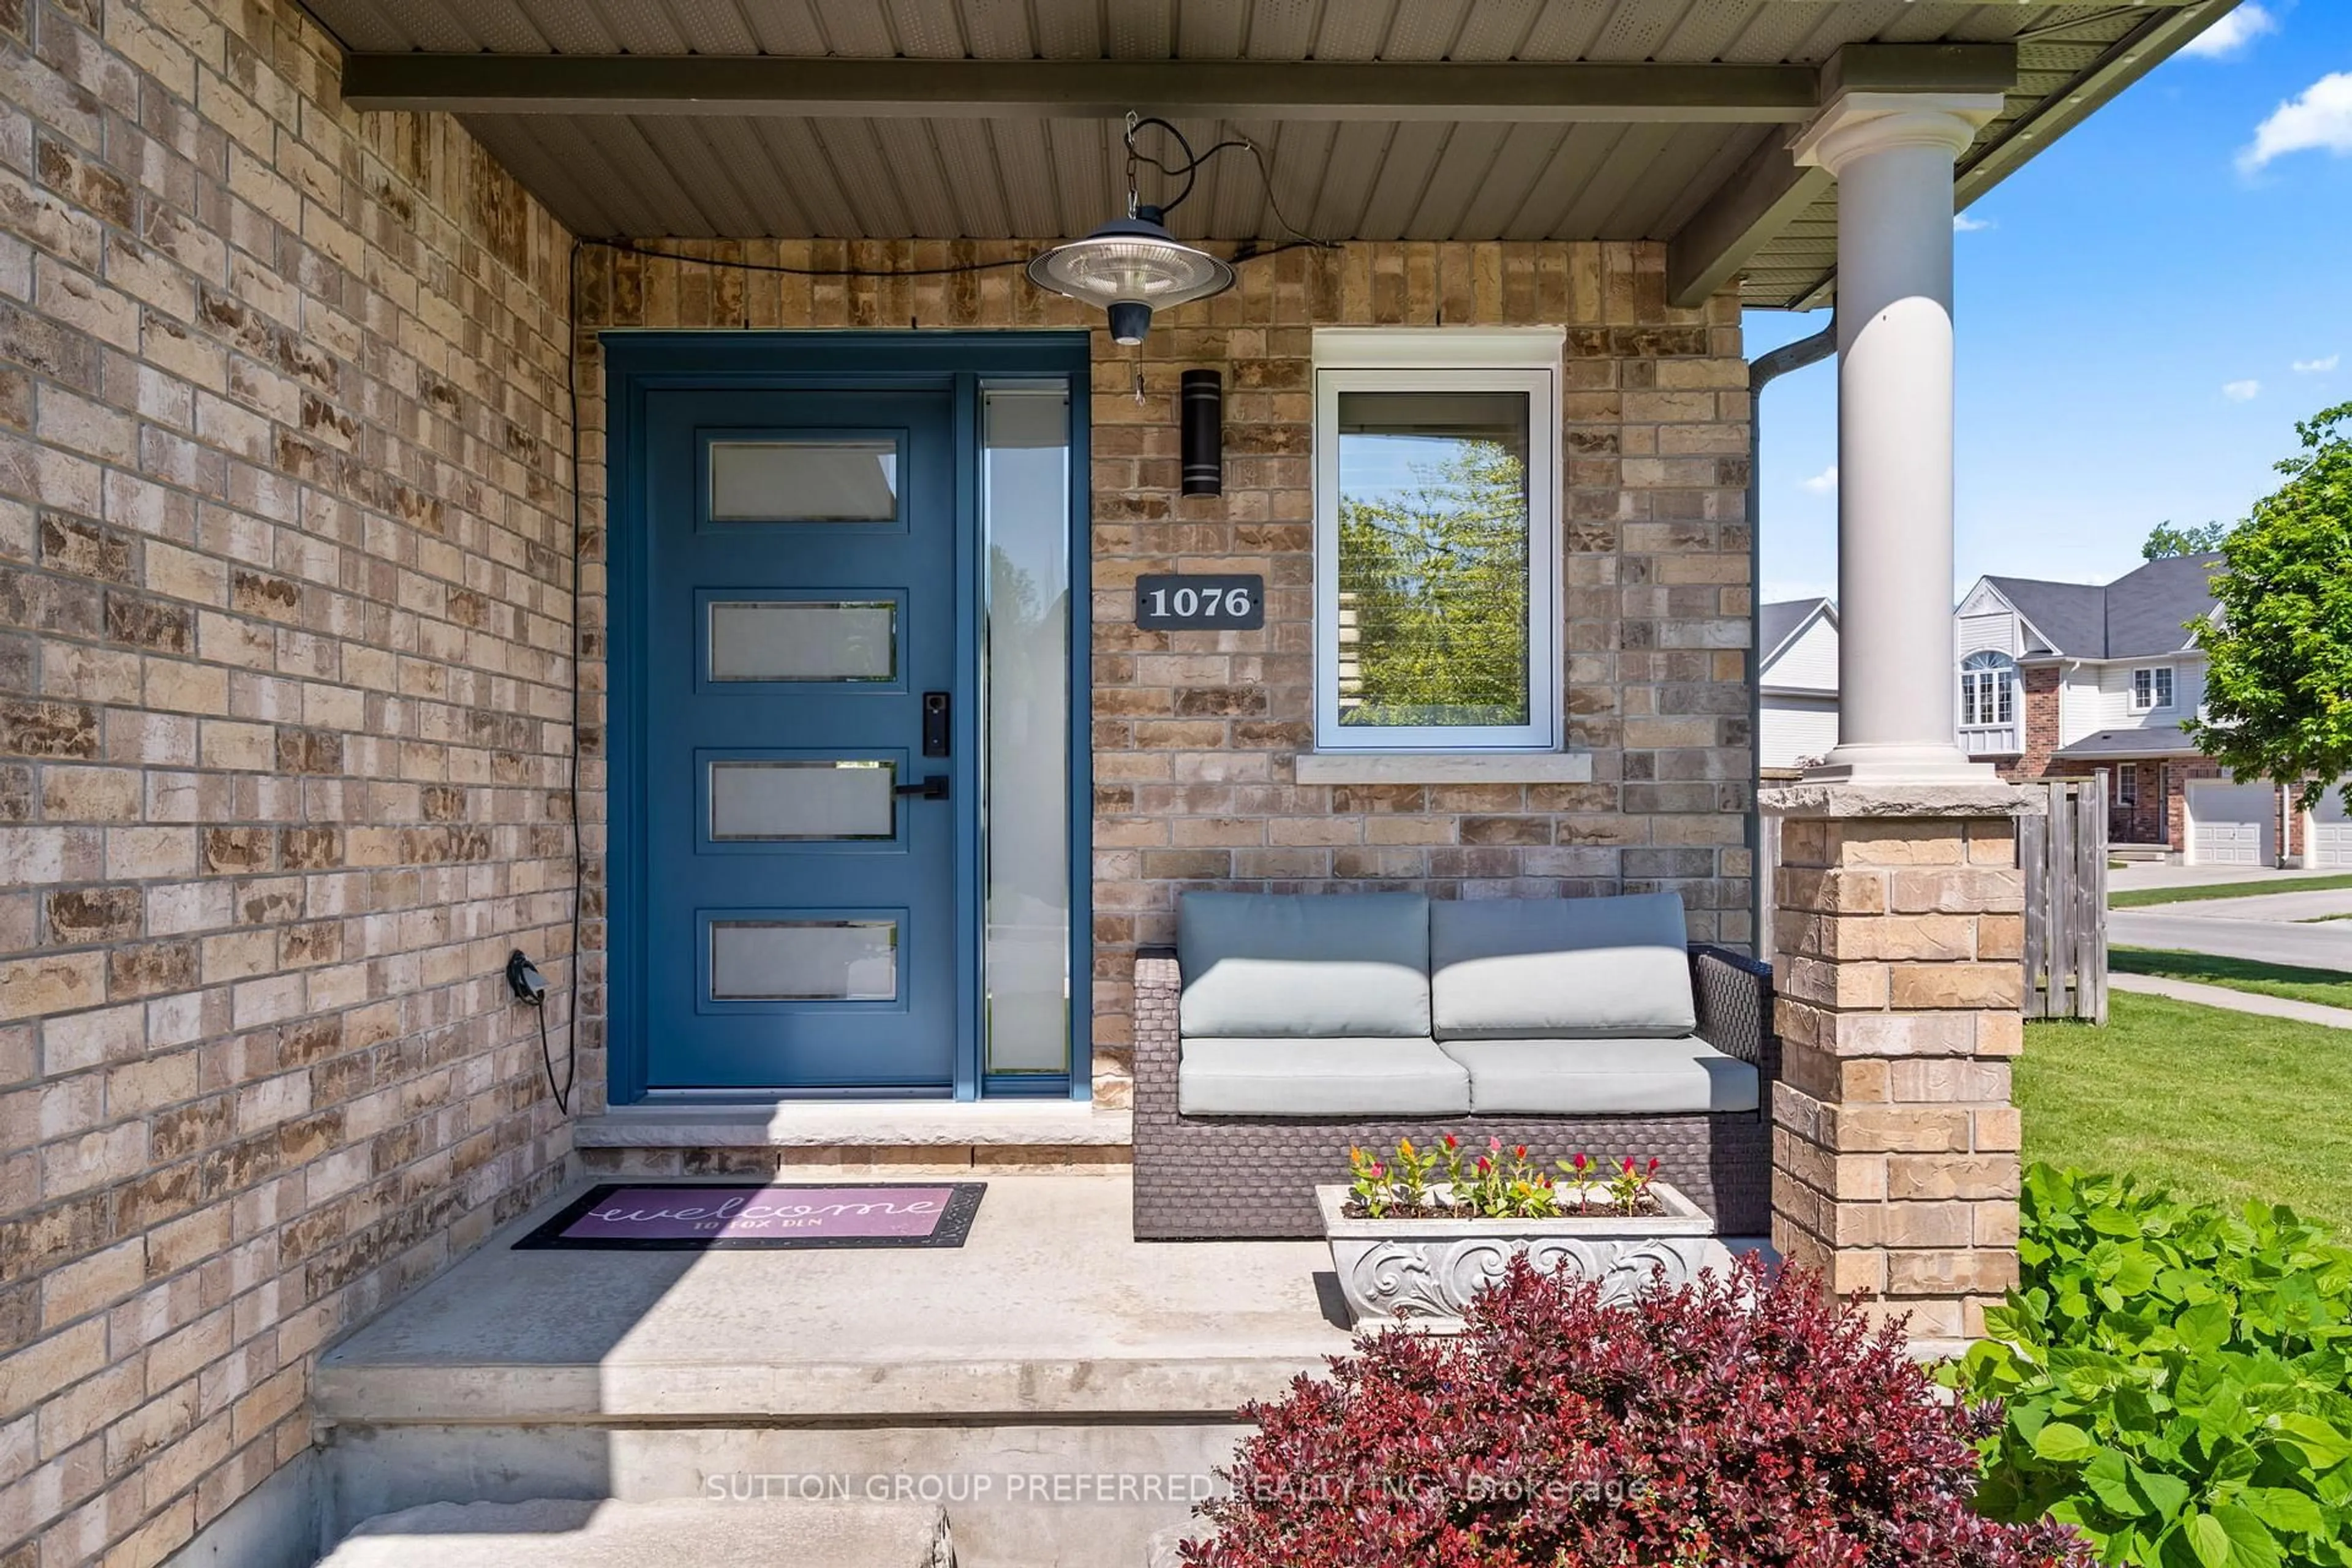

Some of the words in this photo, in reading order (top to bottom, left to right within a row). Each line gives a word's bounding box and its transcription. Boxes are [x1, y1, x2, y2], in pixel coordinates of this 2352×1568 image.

[1150, 588, 1251, 617] 1076
[589, 1197, 943, 1221] welcome
[693, 1221, 720, 1230] TO
[729, 1219, 771, 1230] FOX
[782, 1218, 823, 1227] DEN
